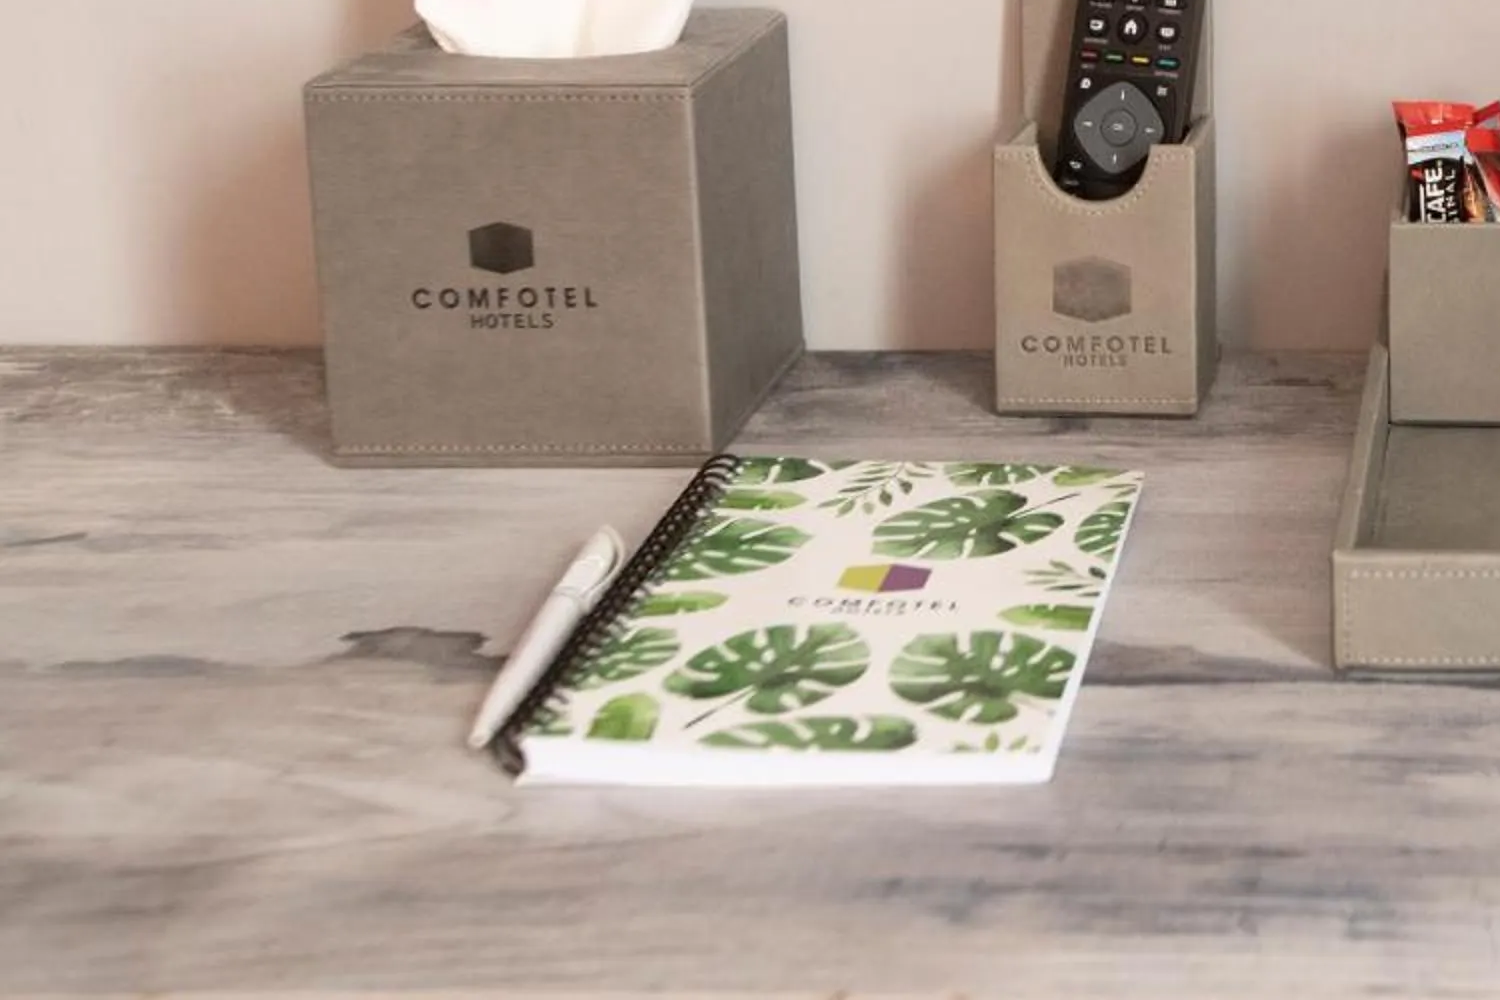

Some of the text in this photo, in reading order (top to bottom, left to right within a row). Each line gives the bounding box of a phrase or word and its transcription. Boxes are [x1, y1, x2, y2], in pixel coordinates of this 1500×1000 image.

[411, 287, 599, 309] COMFOTEL
[470, 313, 555, 329] HOTELS
[1020, 335, 1172, 354] COMFOTEL
